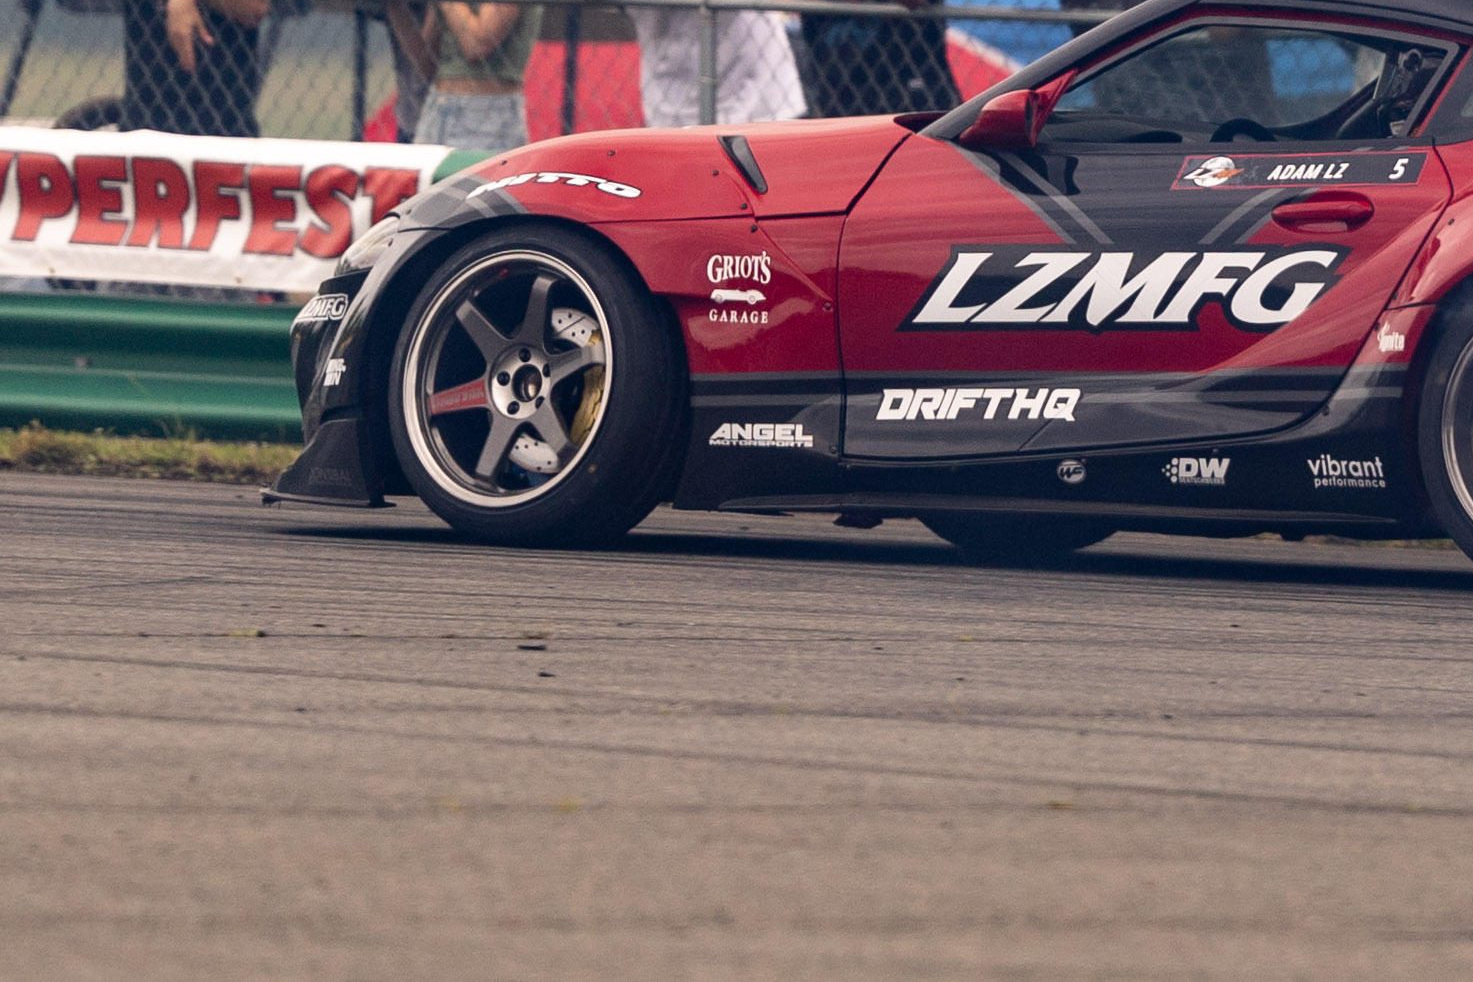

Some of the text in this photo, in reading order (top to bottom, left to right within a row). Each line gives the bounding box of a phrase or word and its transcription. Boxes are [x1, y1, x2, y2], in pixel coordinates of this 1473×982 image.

[1267, 162, 1350, 180] ADAM LZ
[1388, 158, 1409, 180] 5
[707, 251, 771, 284] GRIOT'S
[912, 250, 1338, 326] LZMFG
[709, 309, 768, 324] GARAGE
[710, 423, 813, 441] ANGEL
[709, 439, 813, 447] MOTORSPORTS
[1178, 458, 1231, 478] DW
[1307, 454, 1383, 477] vibrant
[1314, 477, 1386, 489] performance
